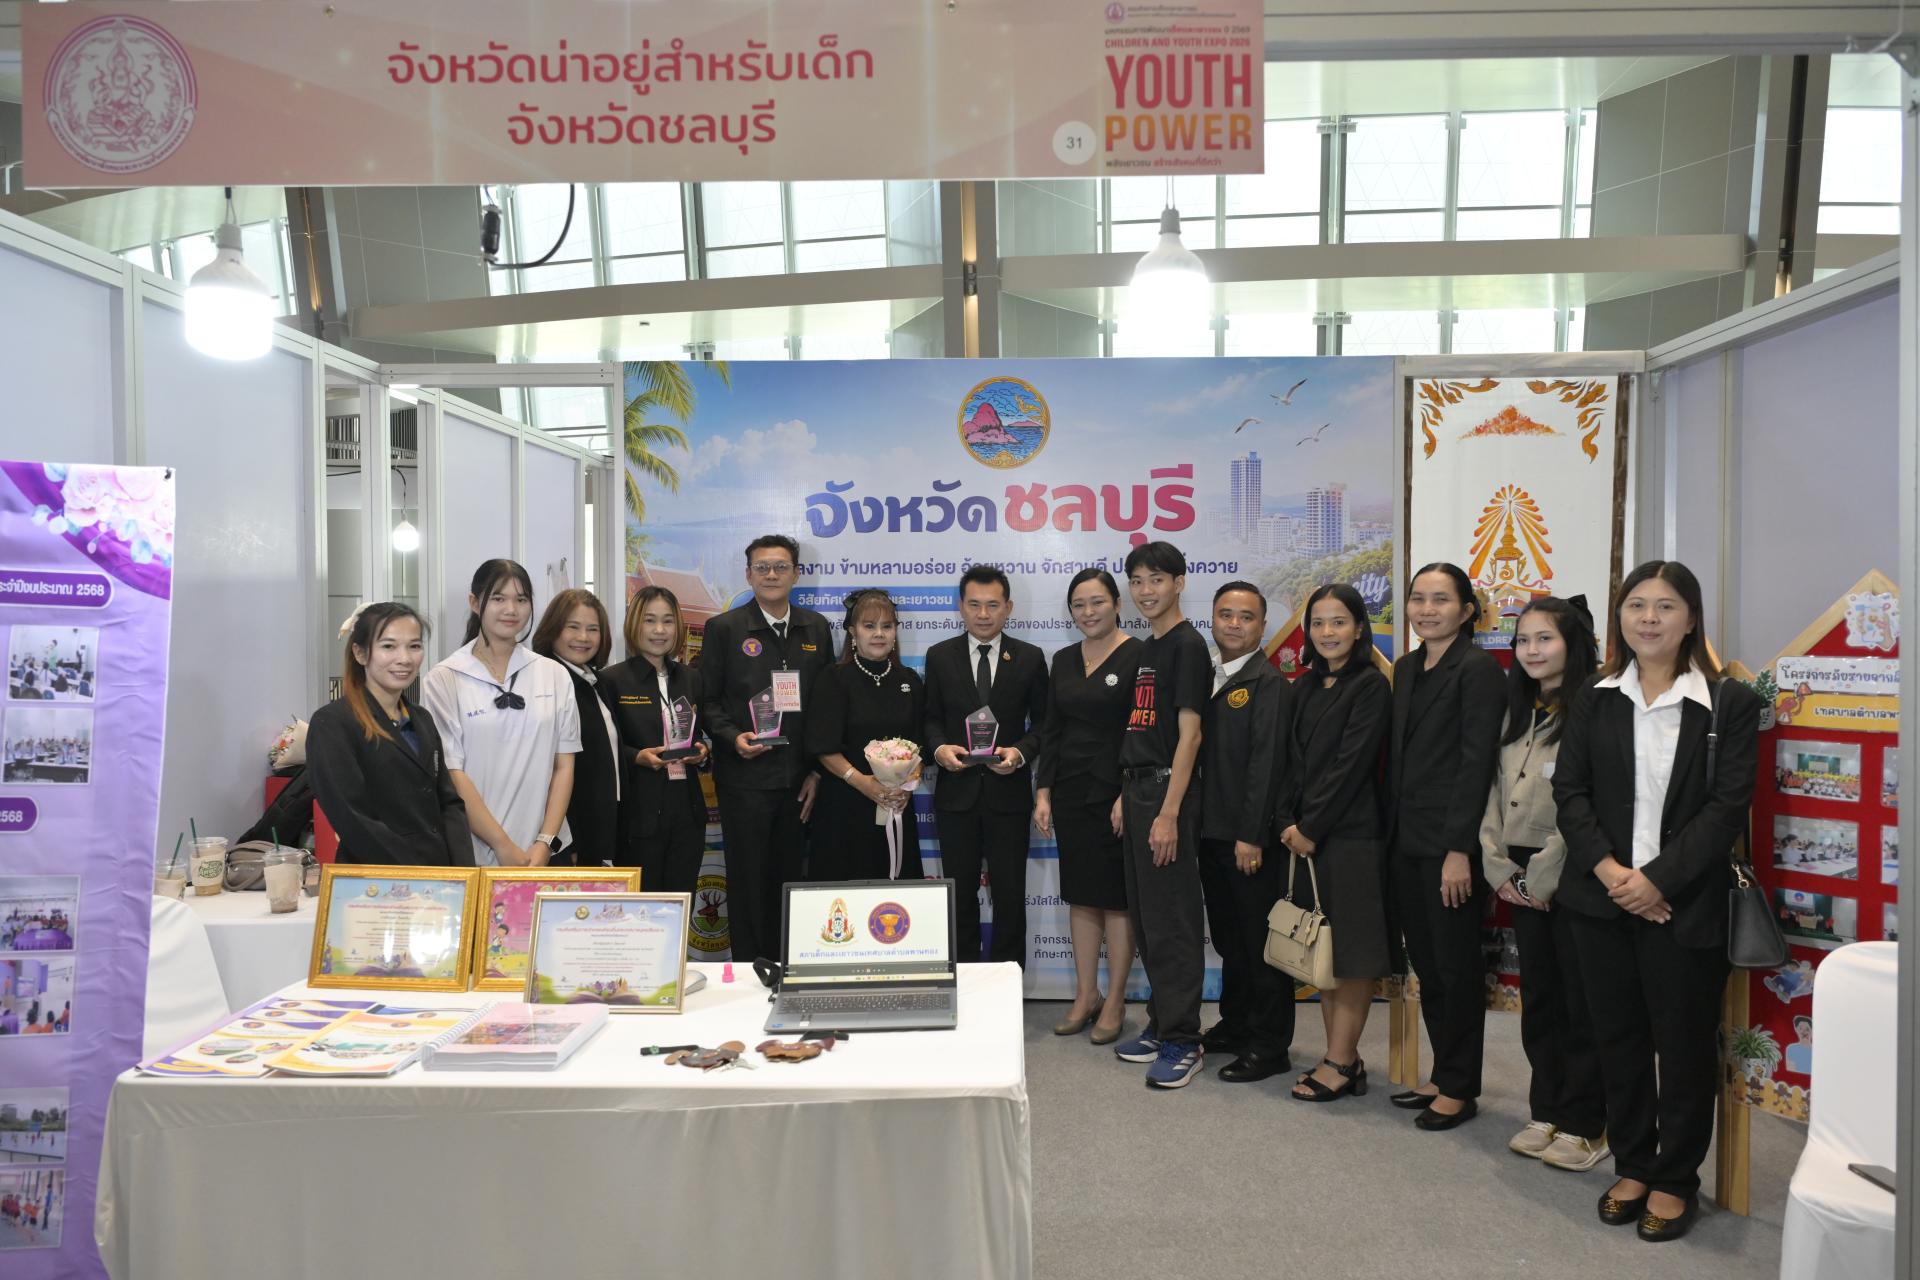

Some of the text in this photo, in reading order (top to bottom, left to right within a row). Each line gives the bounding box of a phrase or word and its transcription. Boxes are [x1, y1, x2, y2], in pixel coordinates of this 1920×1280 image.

[1105, 38, 1149, 48] CHILDREN
[1152, 38, 1170, 48] AND
[1173, 37, 1202, 47] YOUTH
[1204, 37, 1227, 47] EXPO
[387, 33, 875, 96] จังหวัดน่าอยู่สำหรับเด็ก
[1105, 54, 1252, 109] YOUTH
[507, 99, 777, 156] จังหวัดชลบุรี
[1105, 114, 1251, 151] POWER
[1066, 137, 1082, 149] 31
[805, 463, 1196, 550] จังหวัดชลบุรี
[0, 578, 105, 596] ระจำปีงบประมาณ 2568
[1472, 636, 1512, 646] HILDRE
[776, 681, 797, 690] YOUTH
